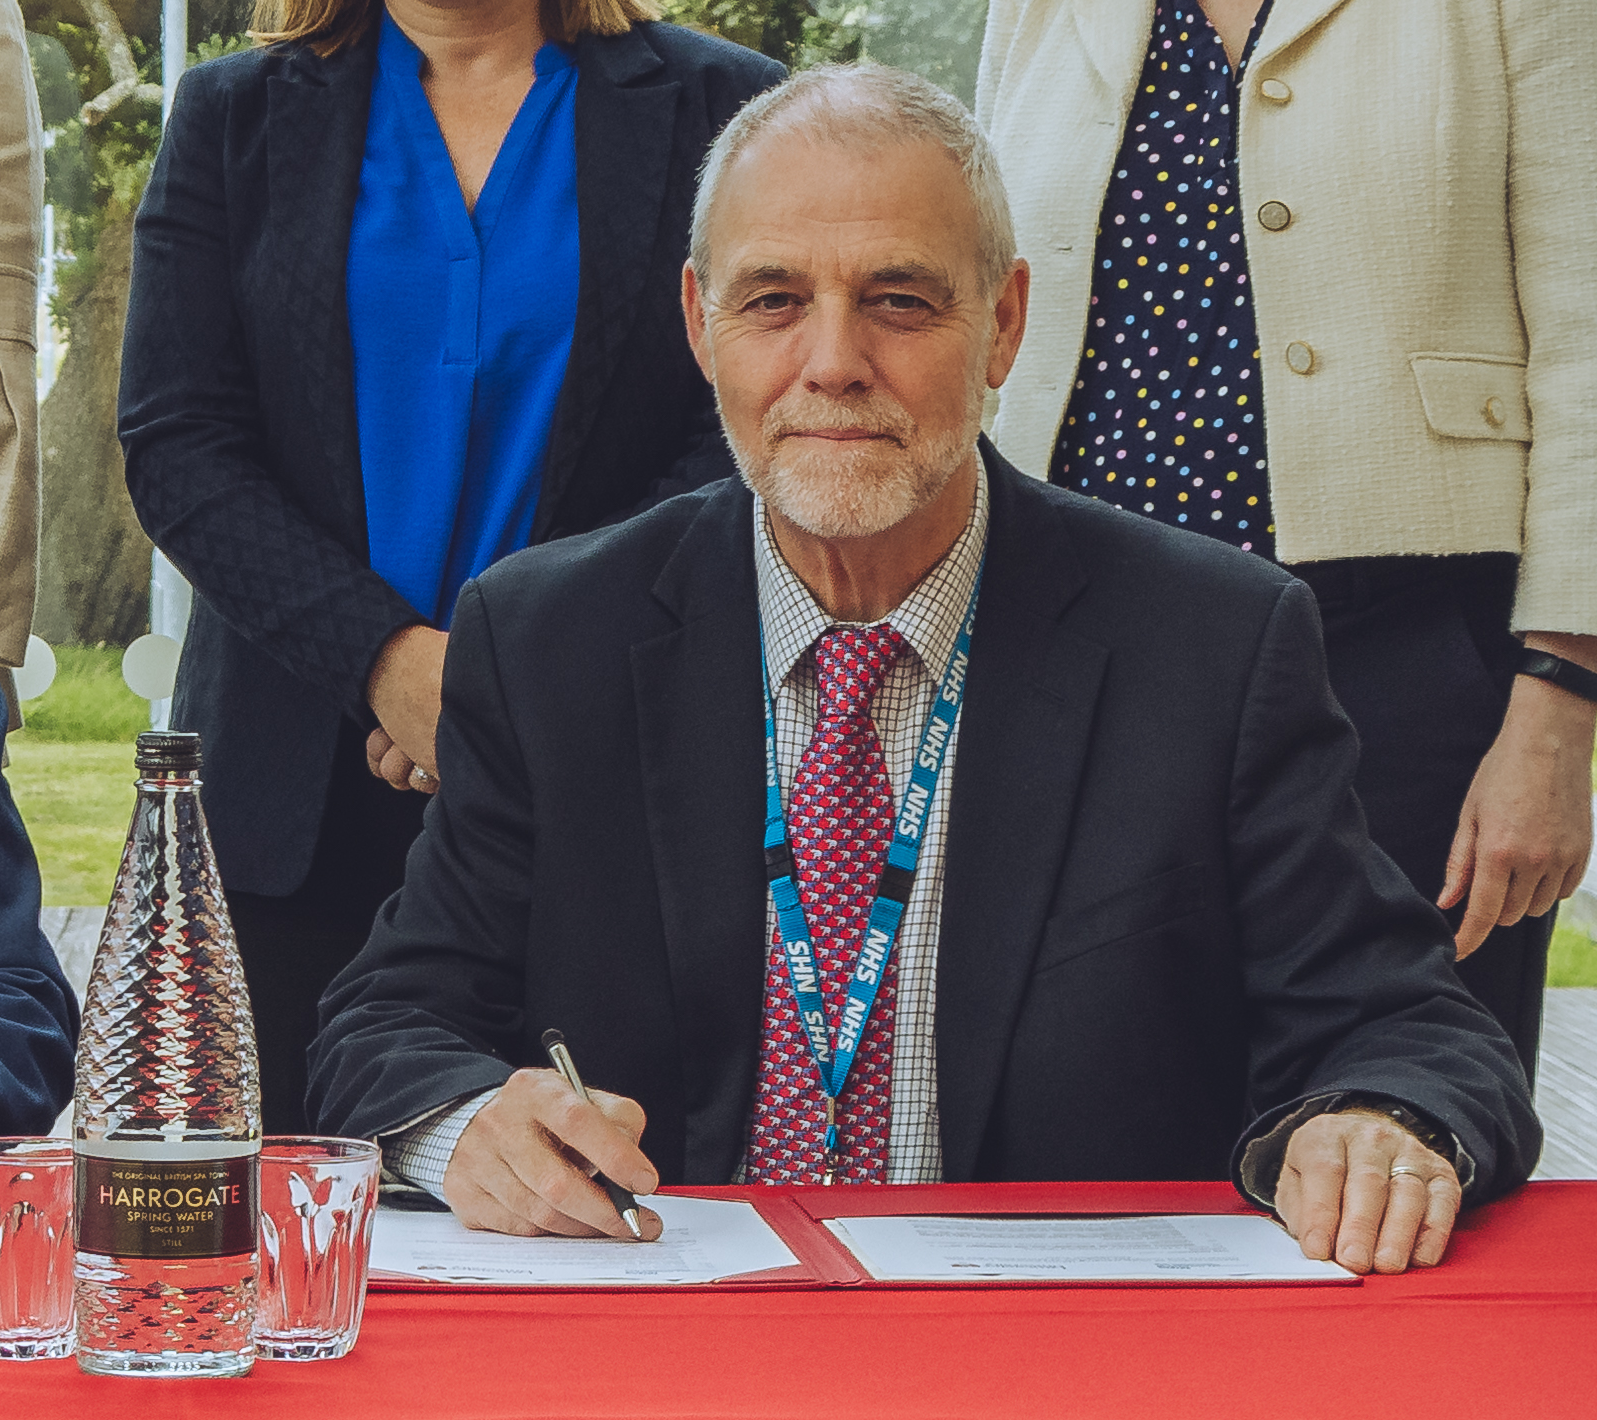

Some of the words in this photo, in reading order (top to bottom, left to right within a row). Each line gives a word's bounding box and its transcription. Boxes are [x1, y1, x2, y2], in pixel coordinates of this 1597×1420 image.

[942, 650, 969, 707] NHS
[919, 716, 950, 773] NHS
[898, 782, 930, 840] NHS
[786, 940, 818, 993] NHS
[857, 928, 890, 986] NHS
[804, 1011, 830, 1063] NHS
[838, 997, 867, 1053] NHS
[99, 1184, 241, 1208] HARROGATE
[127, 1210, 172, 1223] SPRING
[175, 1210, 214, 1222] WATER
[149, 1225, 173, 1234] SINCE
